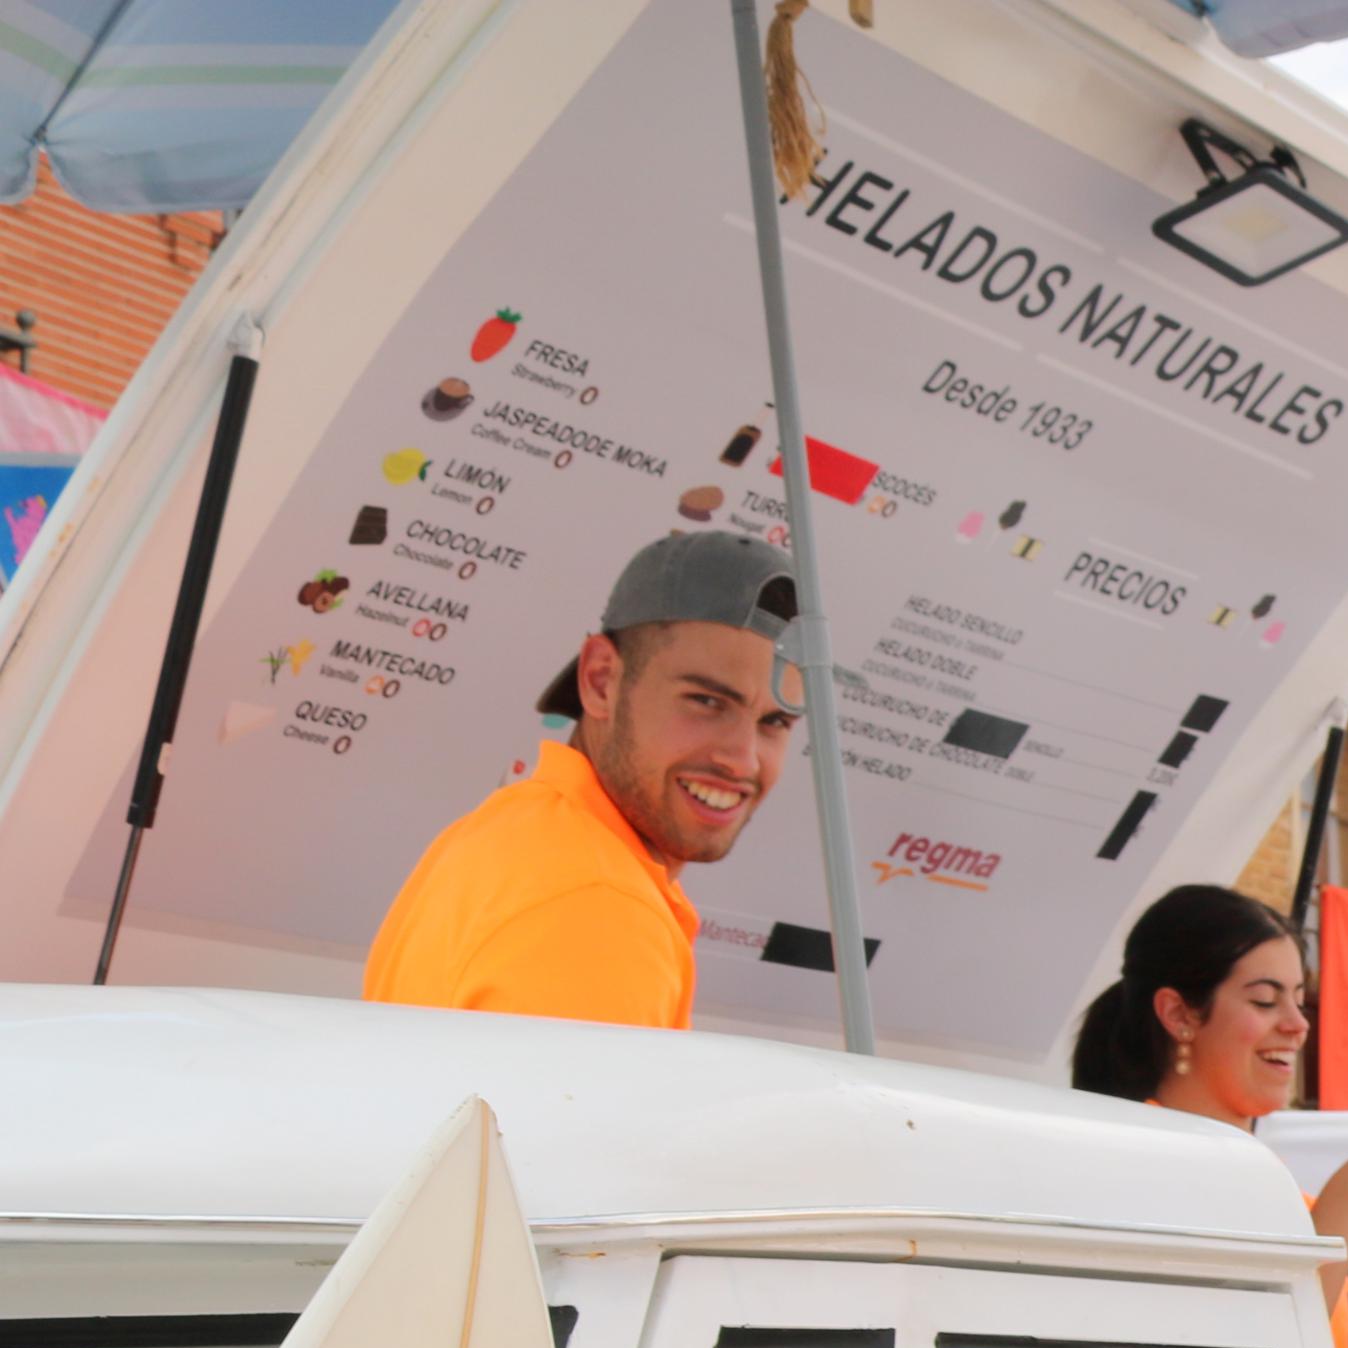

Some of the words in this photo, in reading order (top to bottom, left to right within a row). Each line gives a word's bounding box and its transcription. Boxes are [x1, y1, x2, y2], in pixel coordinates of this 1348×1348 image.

[779, 150, 1071, 320] HELADOS
[1058, 283, 1345, 447] NATURALES
[524, 339, 590, 377] FRESA
[511, 363, 577, 397] Strawberry
[922, 358, 1018, 425] Desde
[1018, 400, 1096, 452] 1933
[471, 424, 510, 447] Coffee
[512, 437, 551, 460] Cream
[444, 458, 512, 494] LIMÓN
[610, 445, 669, 479] MOKA
[431, 482, 473, 505] Lemon
[870, 470, 938, 508] SCOCÉS
[393, 543, 454, 570] Chocolate
[406, 520, 526, 570] CHOCOLATE
[366, 580, 470, 622] AVELLANA
[1064, 552, 1187, 617] PRECIOS
[354, 604, 410, 628] Hazelnut
[903, 594, 961, 624] HELADO
[319, 664, 360, 684] Vanilla
[330, 639, 456, 686] MANTECADO
[873, 636, 932, 667] HELADO
[931, 651, 979, 681] DOBLE
[294, 700, 368, 732] QUESO
[283, 725, 330, 745] Cheese
[861, 757, 913, 782] HELADO
[886, 831, 1002, 879] regma
